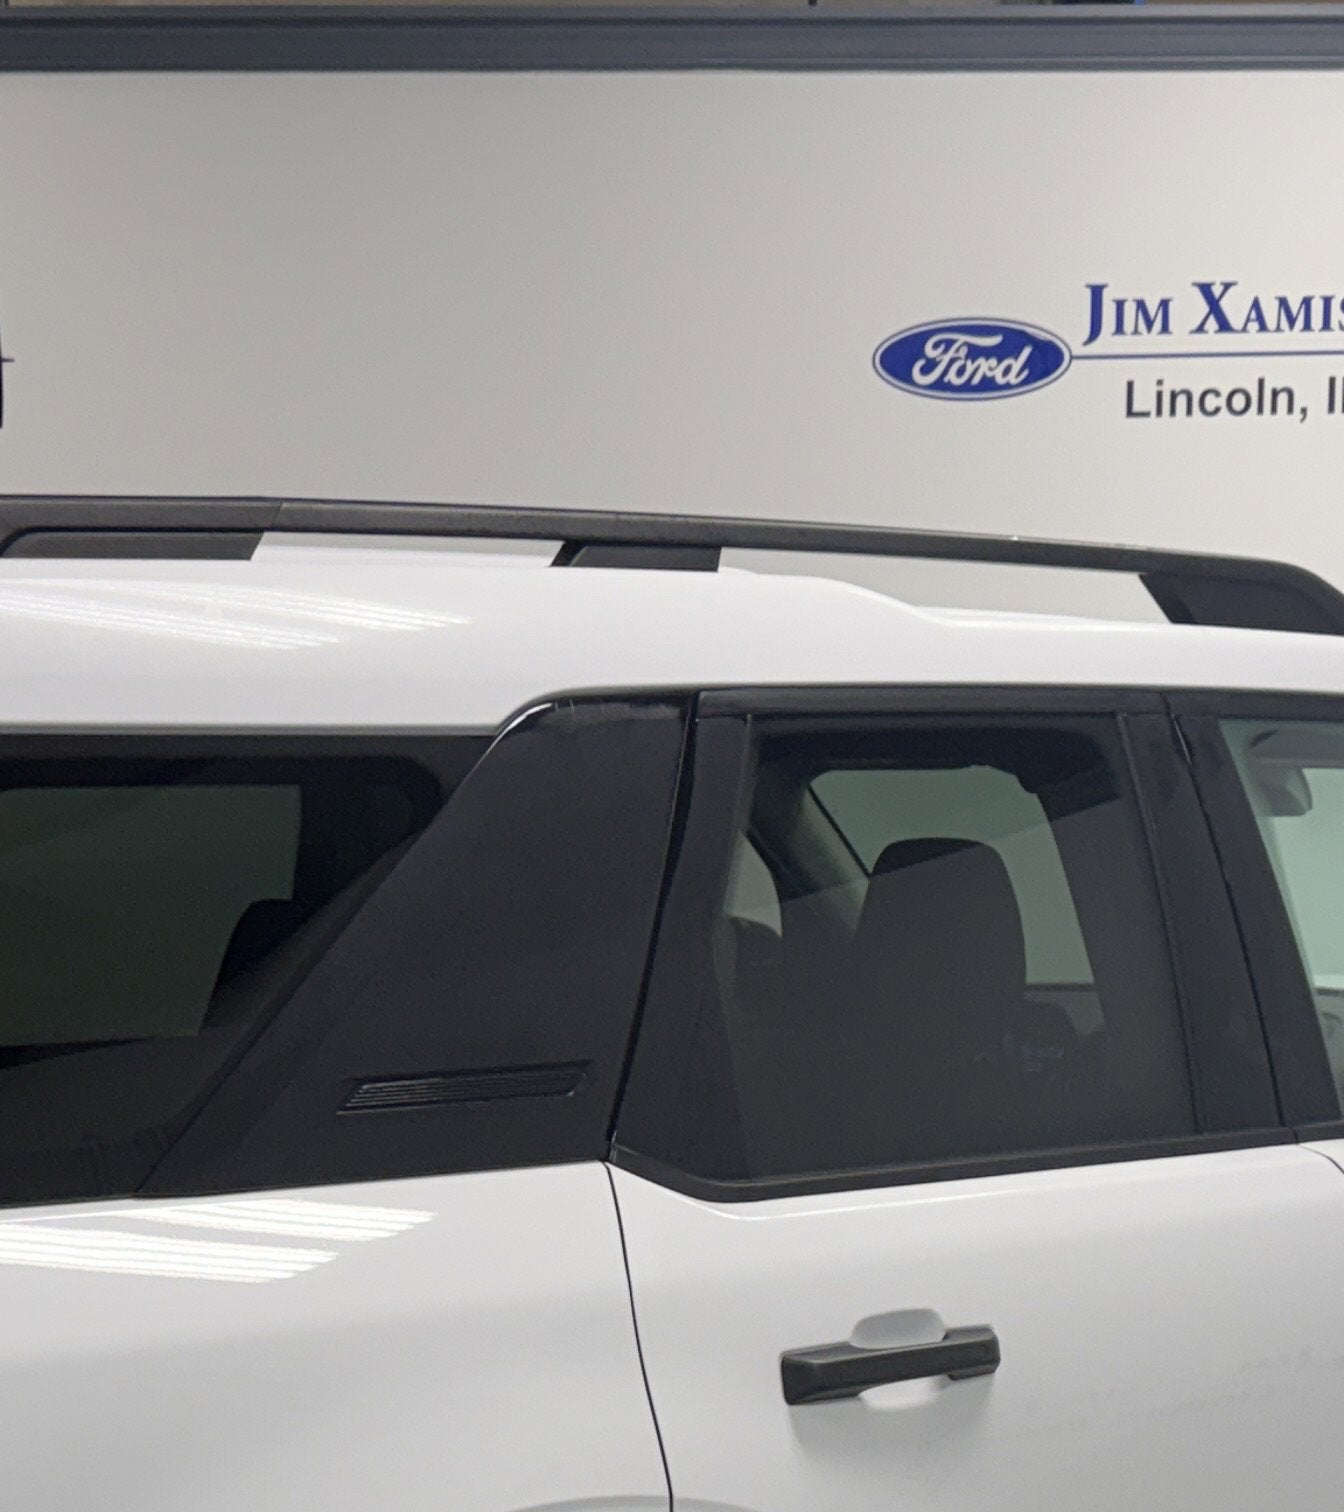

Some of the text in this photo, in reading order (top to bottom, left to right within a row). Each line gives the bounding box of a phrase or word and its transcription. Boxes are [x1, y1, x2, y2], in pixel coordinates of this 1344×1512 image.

[1083, 283, 1173, 346] JIM
[911, 332, 1034, 385] Ford
[1125, 377, 1308, 423] Lincoln,
